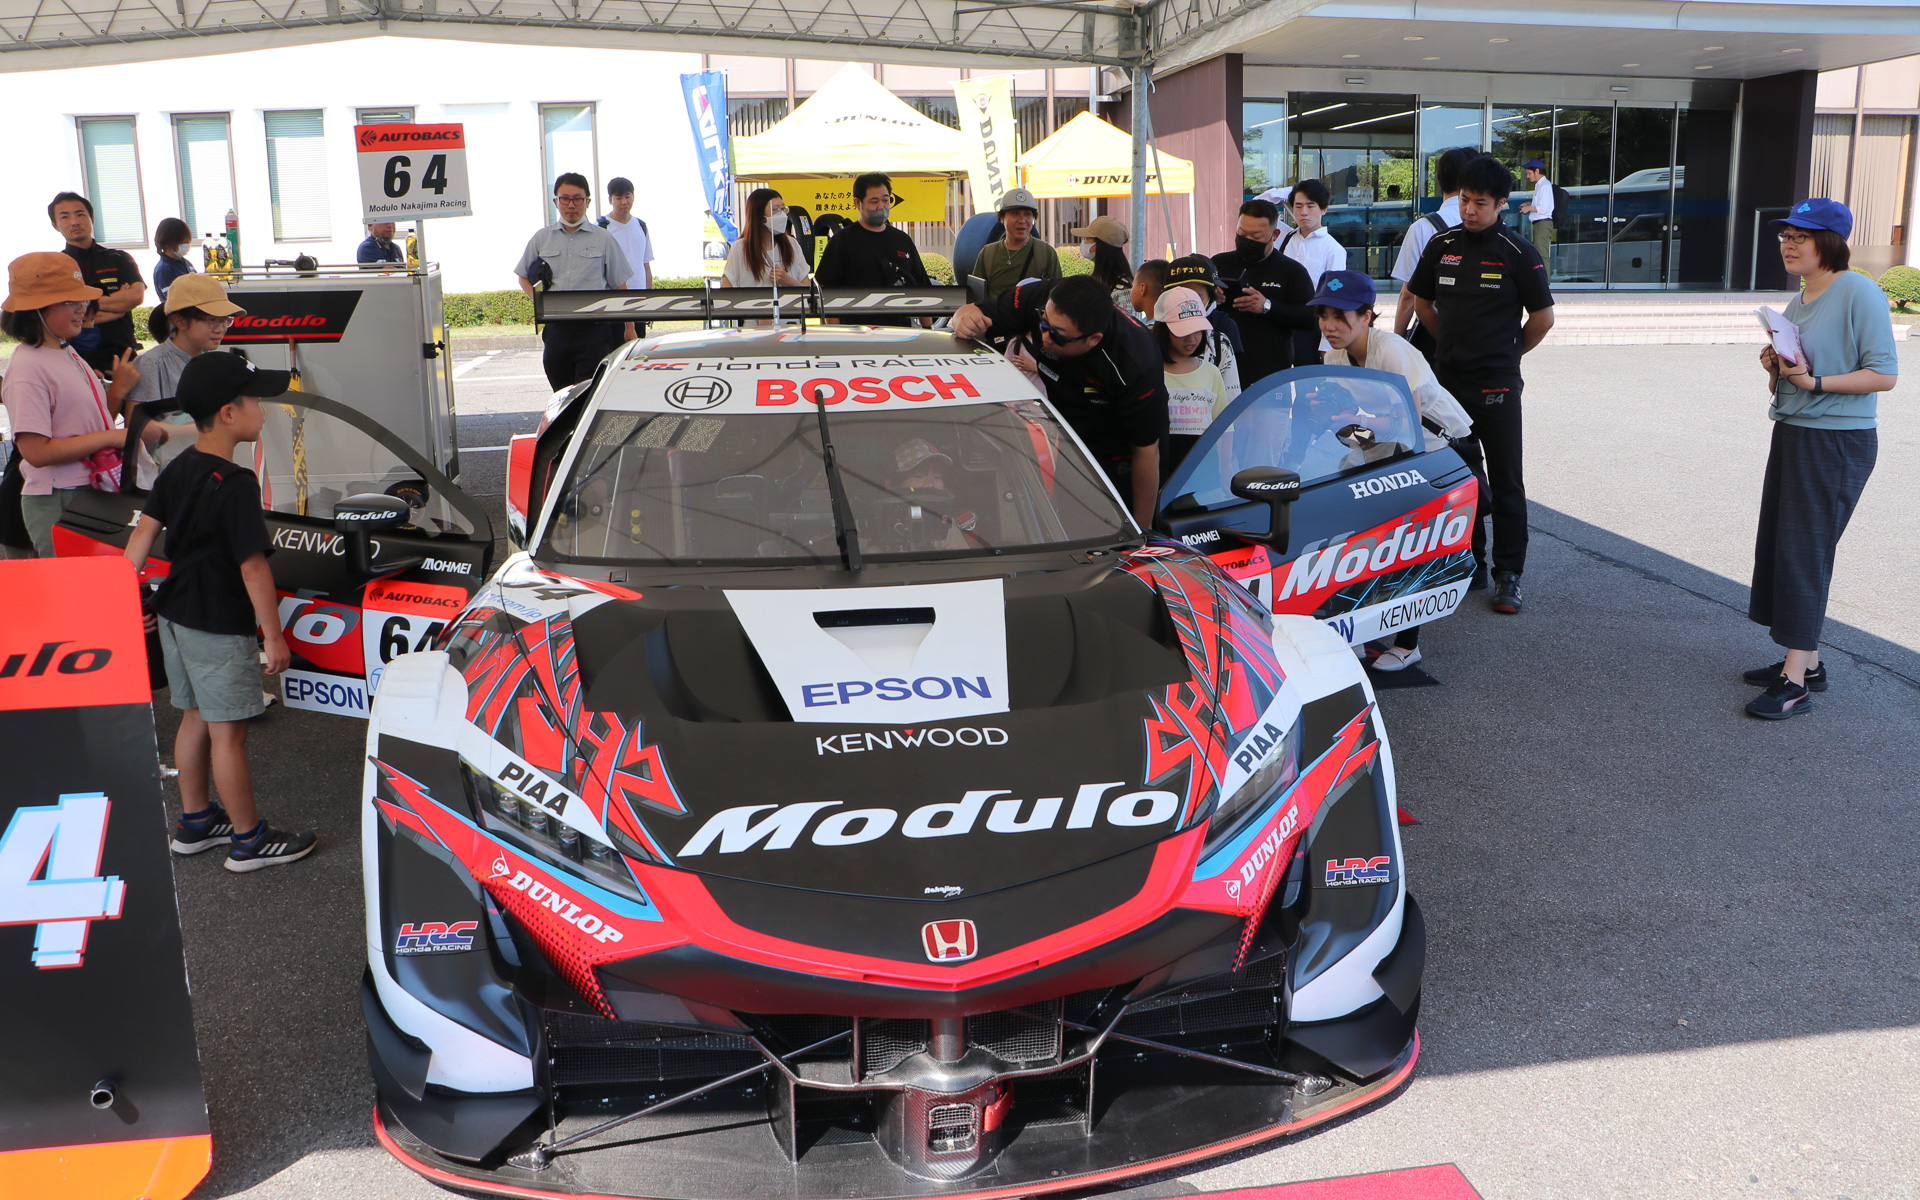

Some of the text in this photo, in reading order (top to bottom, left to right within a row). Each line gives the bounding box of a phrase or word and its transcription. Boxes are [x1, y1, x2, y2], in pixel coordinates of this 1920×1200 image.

[379, 131, 461, 142] AUTOBACS
[383, 154, 448, 198] 64
[1082, 175, 1157, 185] DUNLP
[369, 199, 467, 213] Modulo Nakajima Racing
[815, 192, 854, 200] あなたのタ
[572, 292, 943, 312] Modulo
[231, 314, 328, 328] Modulo
[696, 360, 841, 371] Honda
[851, 357, 996, 369] RACING
[756, 373, 981, 406] BOSCH
[1485, 394, 1504, 405] 64
[1246, 481, 1300, 490] Modulo
[1348, 469, 1427, 499] HONDA
[336, 510, 398, 521] Modulo
[272, 527, 381, 559] KENWOD
[1278, 509, 1469, 602] Modulo
[1220, 555, 1265, 571] TOBACS
[385, 592, 460, 608] AUTOBACS
[1379, 588, 1458, 631] KENWOOD
[285, 676, 364, 710] EPSON
[801, 676, 992, 708] EPSON
[816, 727, 1009, 755] KENWOOD
[1234, 722, 1284, 774] PIAA
[497, 761, 570, 817] PIAA
[676, 781, 1180, 858] Modulo
[1240, 804, 1300, 887] DUNLOP
[1325, 856, 1390, 881] HRC
[1326, 876, 1390, 887] Honda RACING
[507, 870, 624, 944] DUNLOP
[396, 921, 479, 948] HRC
[396, 944, 472, 953] Honda RACING
